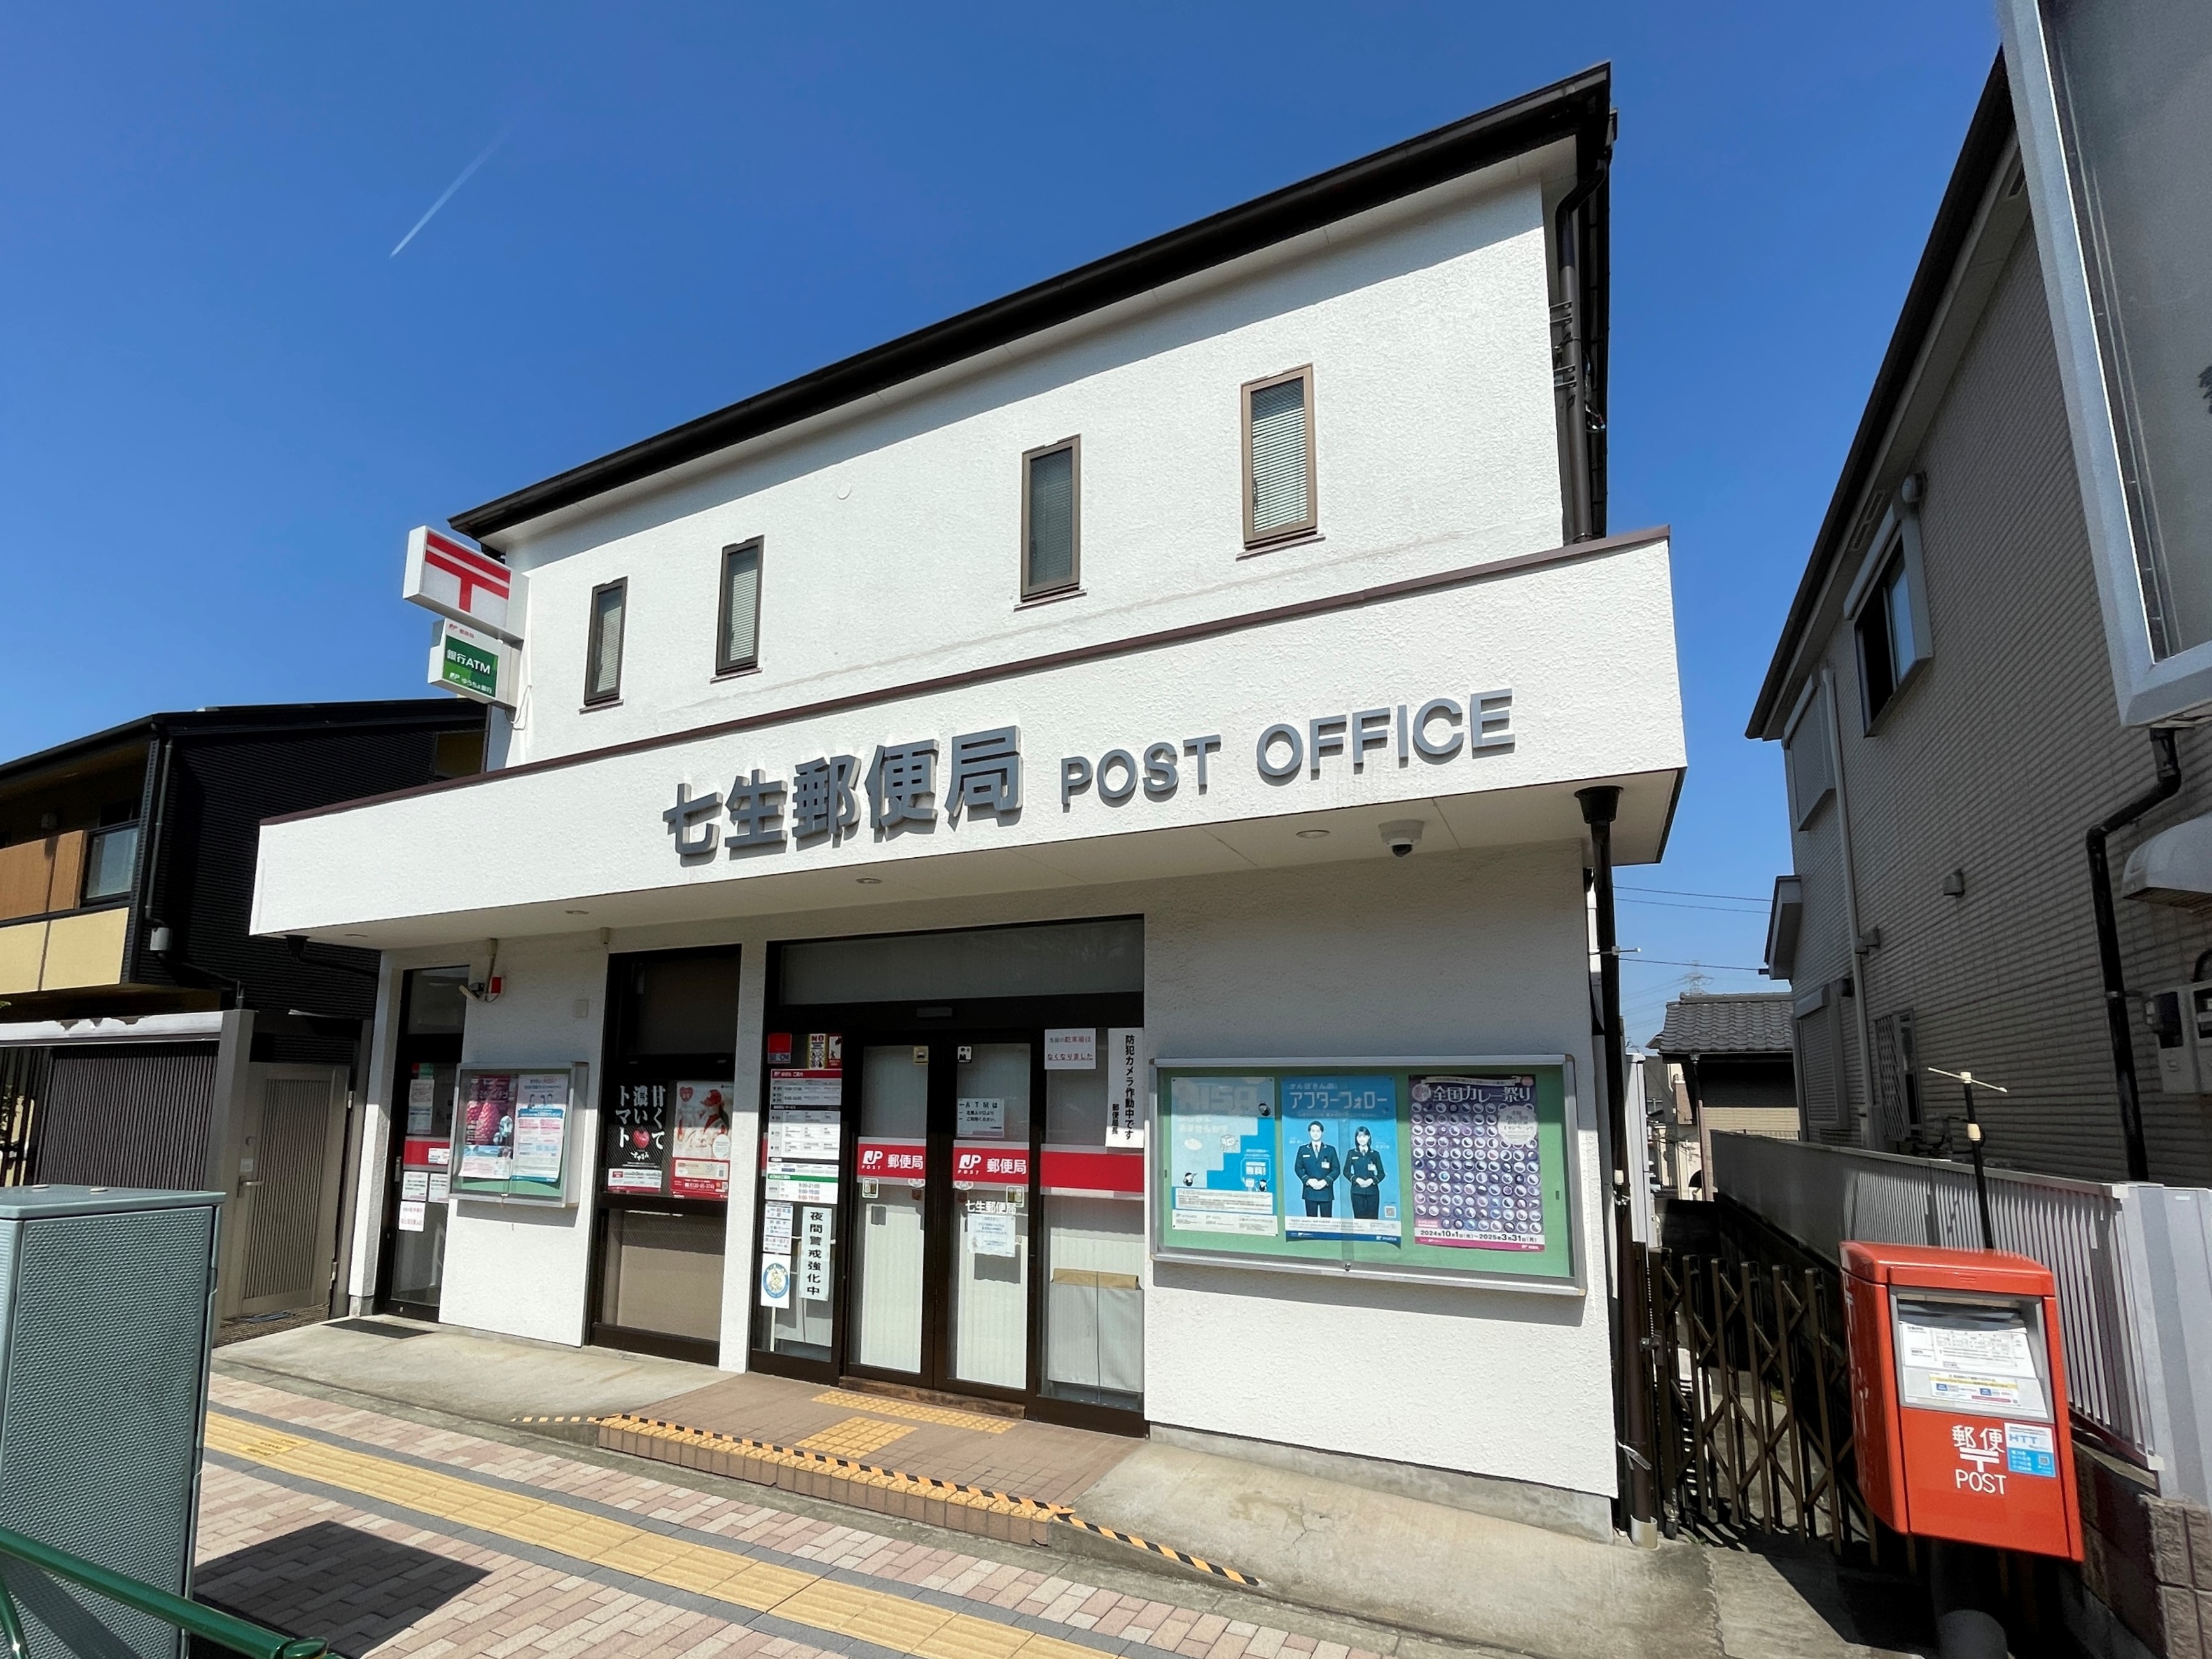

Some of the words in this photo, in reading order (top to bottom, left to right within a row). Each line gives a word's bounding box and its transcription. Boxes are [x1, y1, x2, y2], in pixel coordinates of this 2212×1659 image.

[447, 649, 490, 675] 銀行ATM
[663, 725, 1024, 858] 七生郵便局
[1061, 734, 1221, 807] POST
[1256, 688, 1517, 785] OFFICE
[1125, 1035, 1135, 1140] 防犯カメラ作動中です
[1289, 1091, 1388, 1109] アフターフォロー
[1432, 1084, 1531, 1103] 全国カレー祭り
[615, 1085, 631, 1148] トマト
[651, 1085, 666, 1149] 甘くて
[887, 1154, 924, 1170] 郵便局
[987, 1158, 1027, 1175] 郵便局
[965, 1200, 1017, 1215] 七生郵便局
[807, 1212, 823, 1296] 夜間警戒強化中
[1951, 1424, 2005, 1454] 郵便
[2008, 1433, 2038, 1445] HTT
[1954, 1469, 2007, 1495] POST
